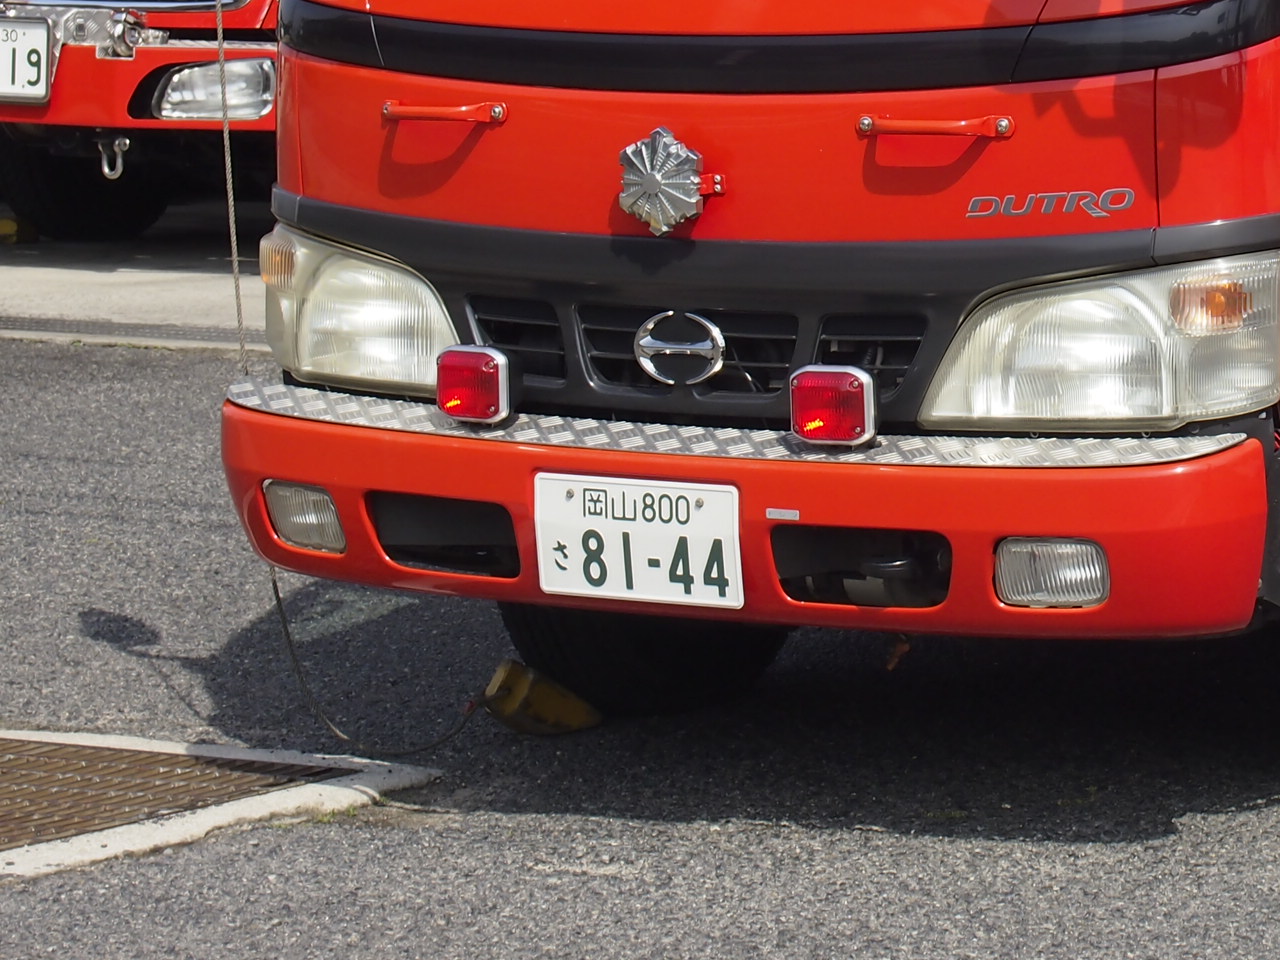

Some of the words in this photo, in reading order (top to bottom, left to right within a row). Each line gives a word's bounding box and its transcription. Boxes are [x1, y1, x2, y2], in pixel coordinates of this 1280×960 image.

[966, 187, 1135, 218] DUTRO
[553, 540, 568, 570] さ
[582, 529, 729, 598] 81-44
